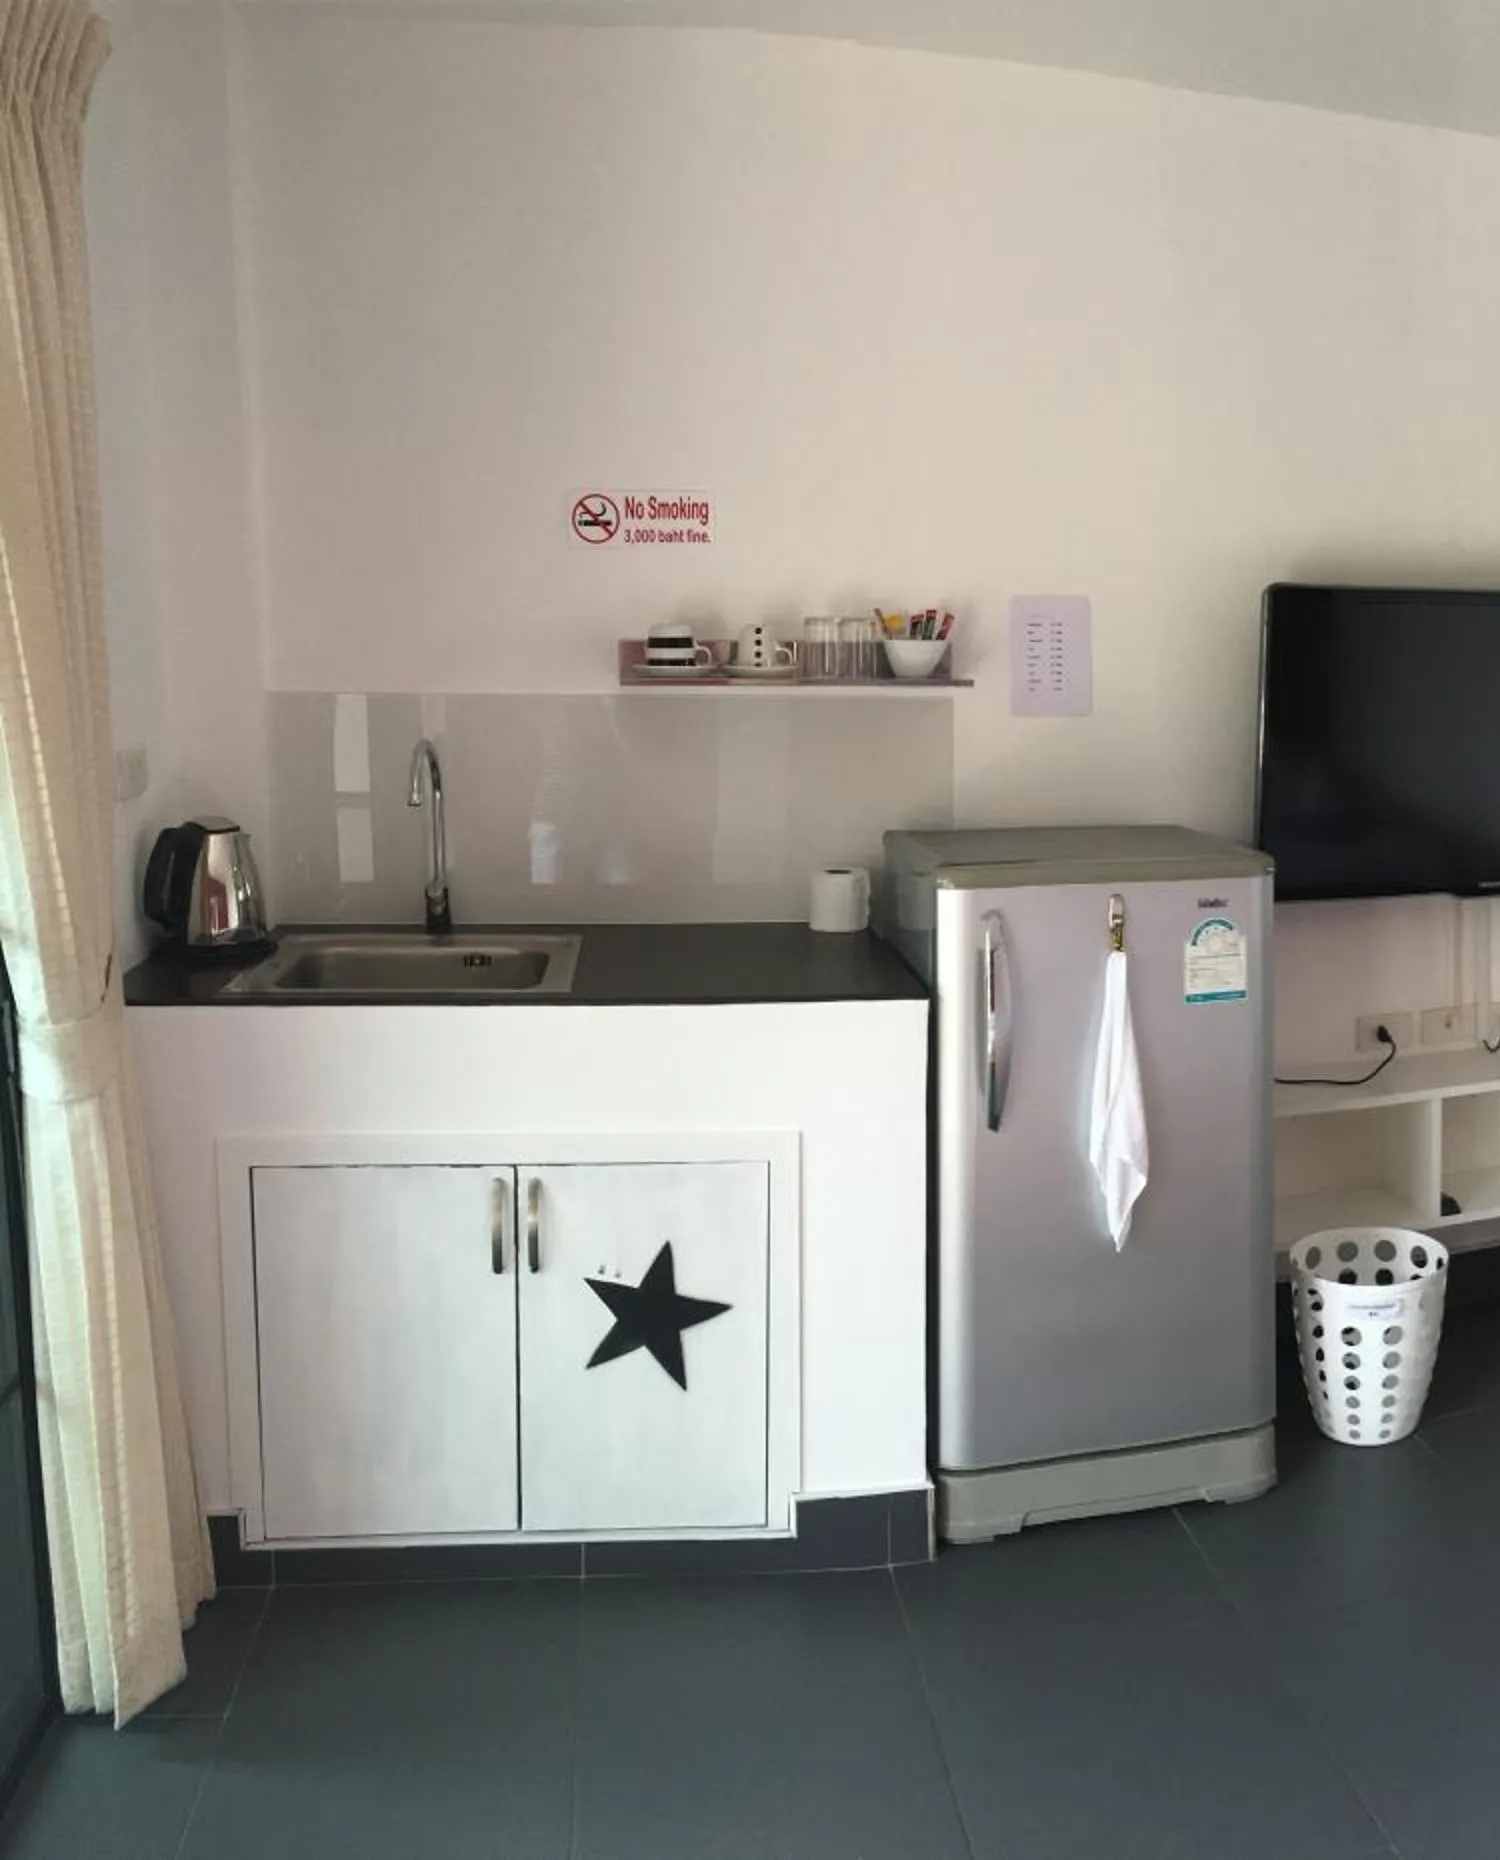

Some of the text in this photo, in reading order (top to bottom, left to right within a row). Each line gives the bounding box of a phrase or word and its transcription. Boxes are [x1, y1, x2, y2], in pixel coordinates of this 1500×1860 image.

[624, 496, 709, 526] No Smoking
[624, 528, 711, 543] 3,000 baht fine.
